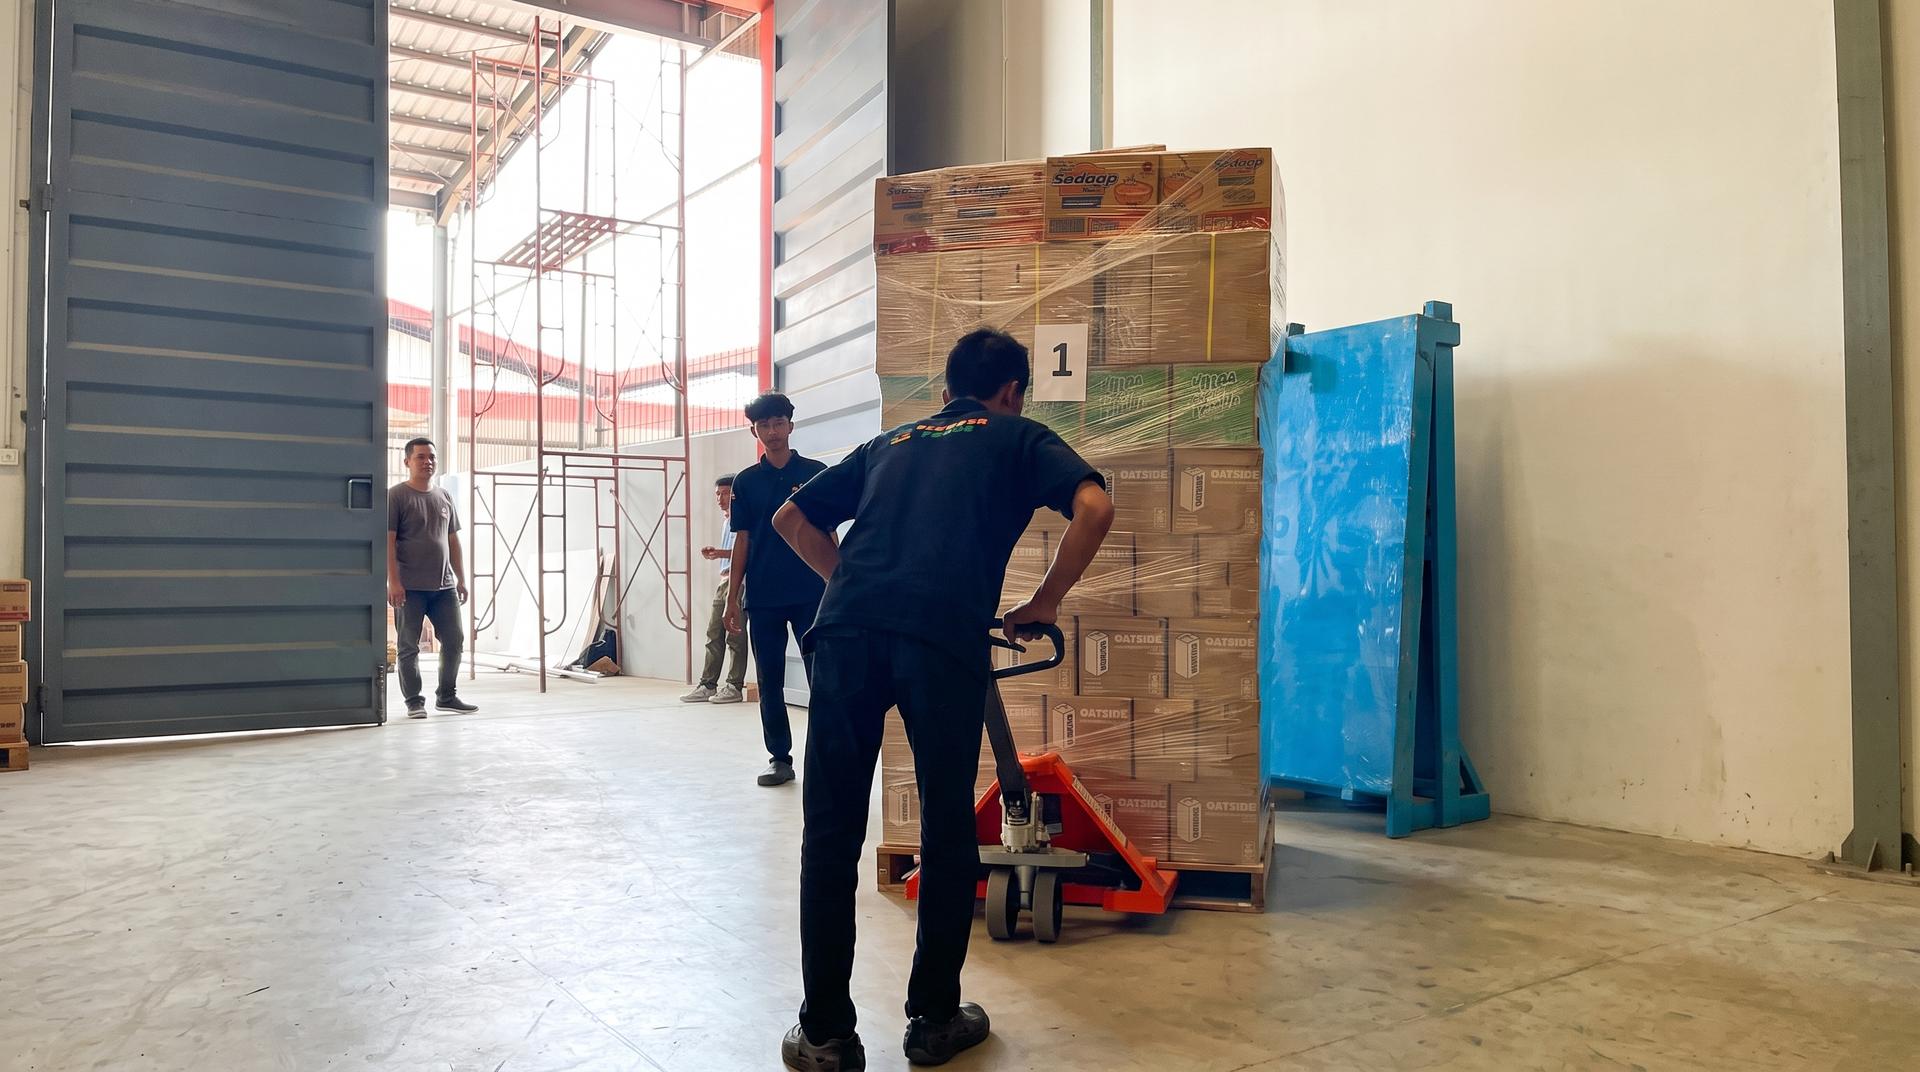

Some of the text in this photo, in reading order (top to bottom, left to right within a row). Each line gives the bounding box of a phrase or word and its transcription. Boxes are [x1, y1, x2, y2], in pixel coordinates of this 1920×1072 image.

[1051, 171, 1119, 187] Sedaap
[1052, 342, 1073, 377] 1
[1119, 469, 1168, 480] OATSIDE
[1211, 469, 1260, 480] OATSIDE
[1114, 634, 1163, 645] OATSIDE
[1204, 637, 1256, 648] OATSIDE
[1079, 708, 1129, 719] OATSIDE
[1118, 798, 1168, 808] OATSIDE
[1206, 800, 1257, 812] OATSIDE
